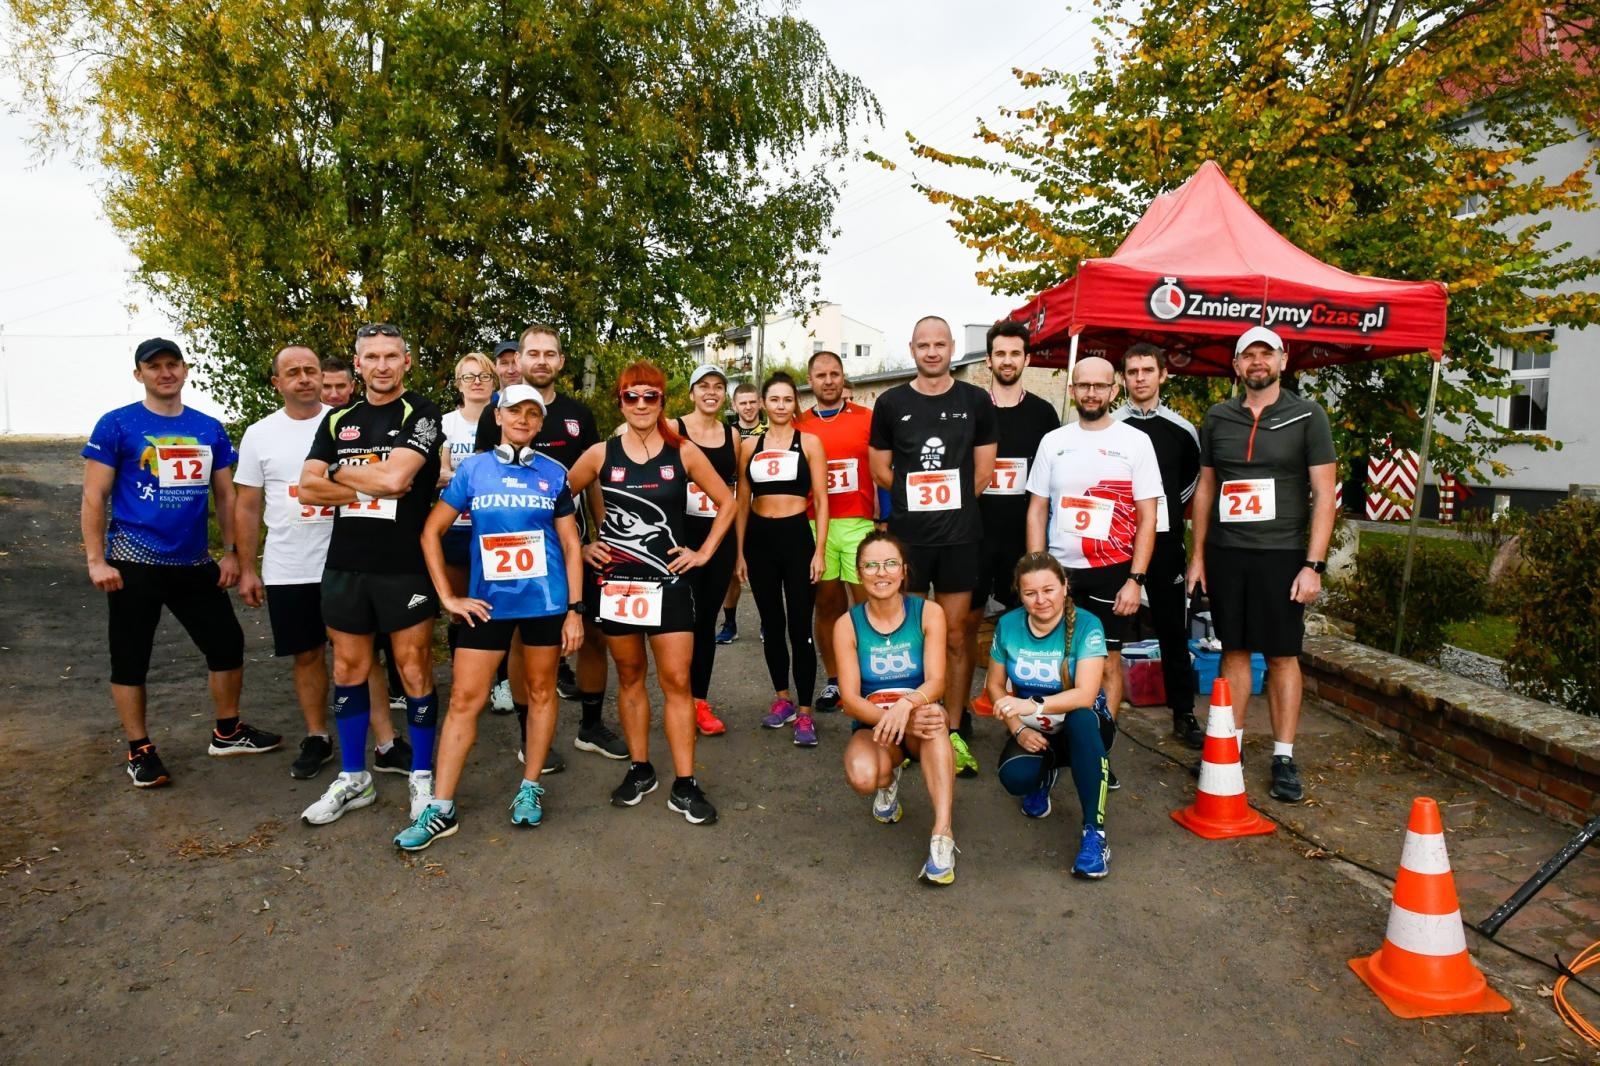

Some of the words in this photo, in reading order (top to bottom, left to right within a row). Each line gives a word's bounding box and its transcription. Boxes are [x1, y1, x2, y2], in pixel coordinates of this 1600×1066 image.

[1187, 294, 1385, 332] ZmierzymyCzas.pl
[172, 459, 203, 480] 12
[767, 460, 780, 476] 8
[827, 471, 850, 490] 31
[989, 471, 1017, 489] 17
[471, 493, 556, 511] RUNNERS
[918, 484, 951, 506] 30
[1228, 495, 1263, 516] 24
[1075, 510, 1091, 531] 9
[494, 548, 534, 573] 20
[614, 597, 649, 619] 10
